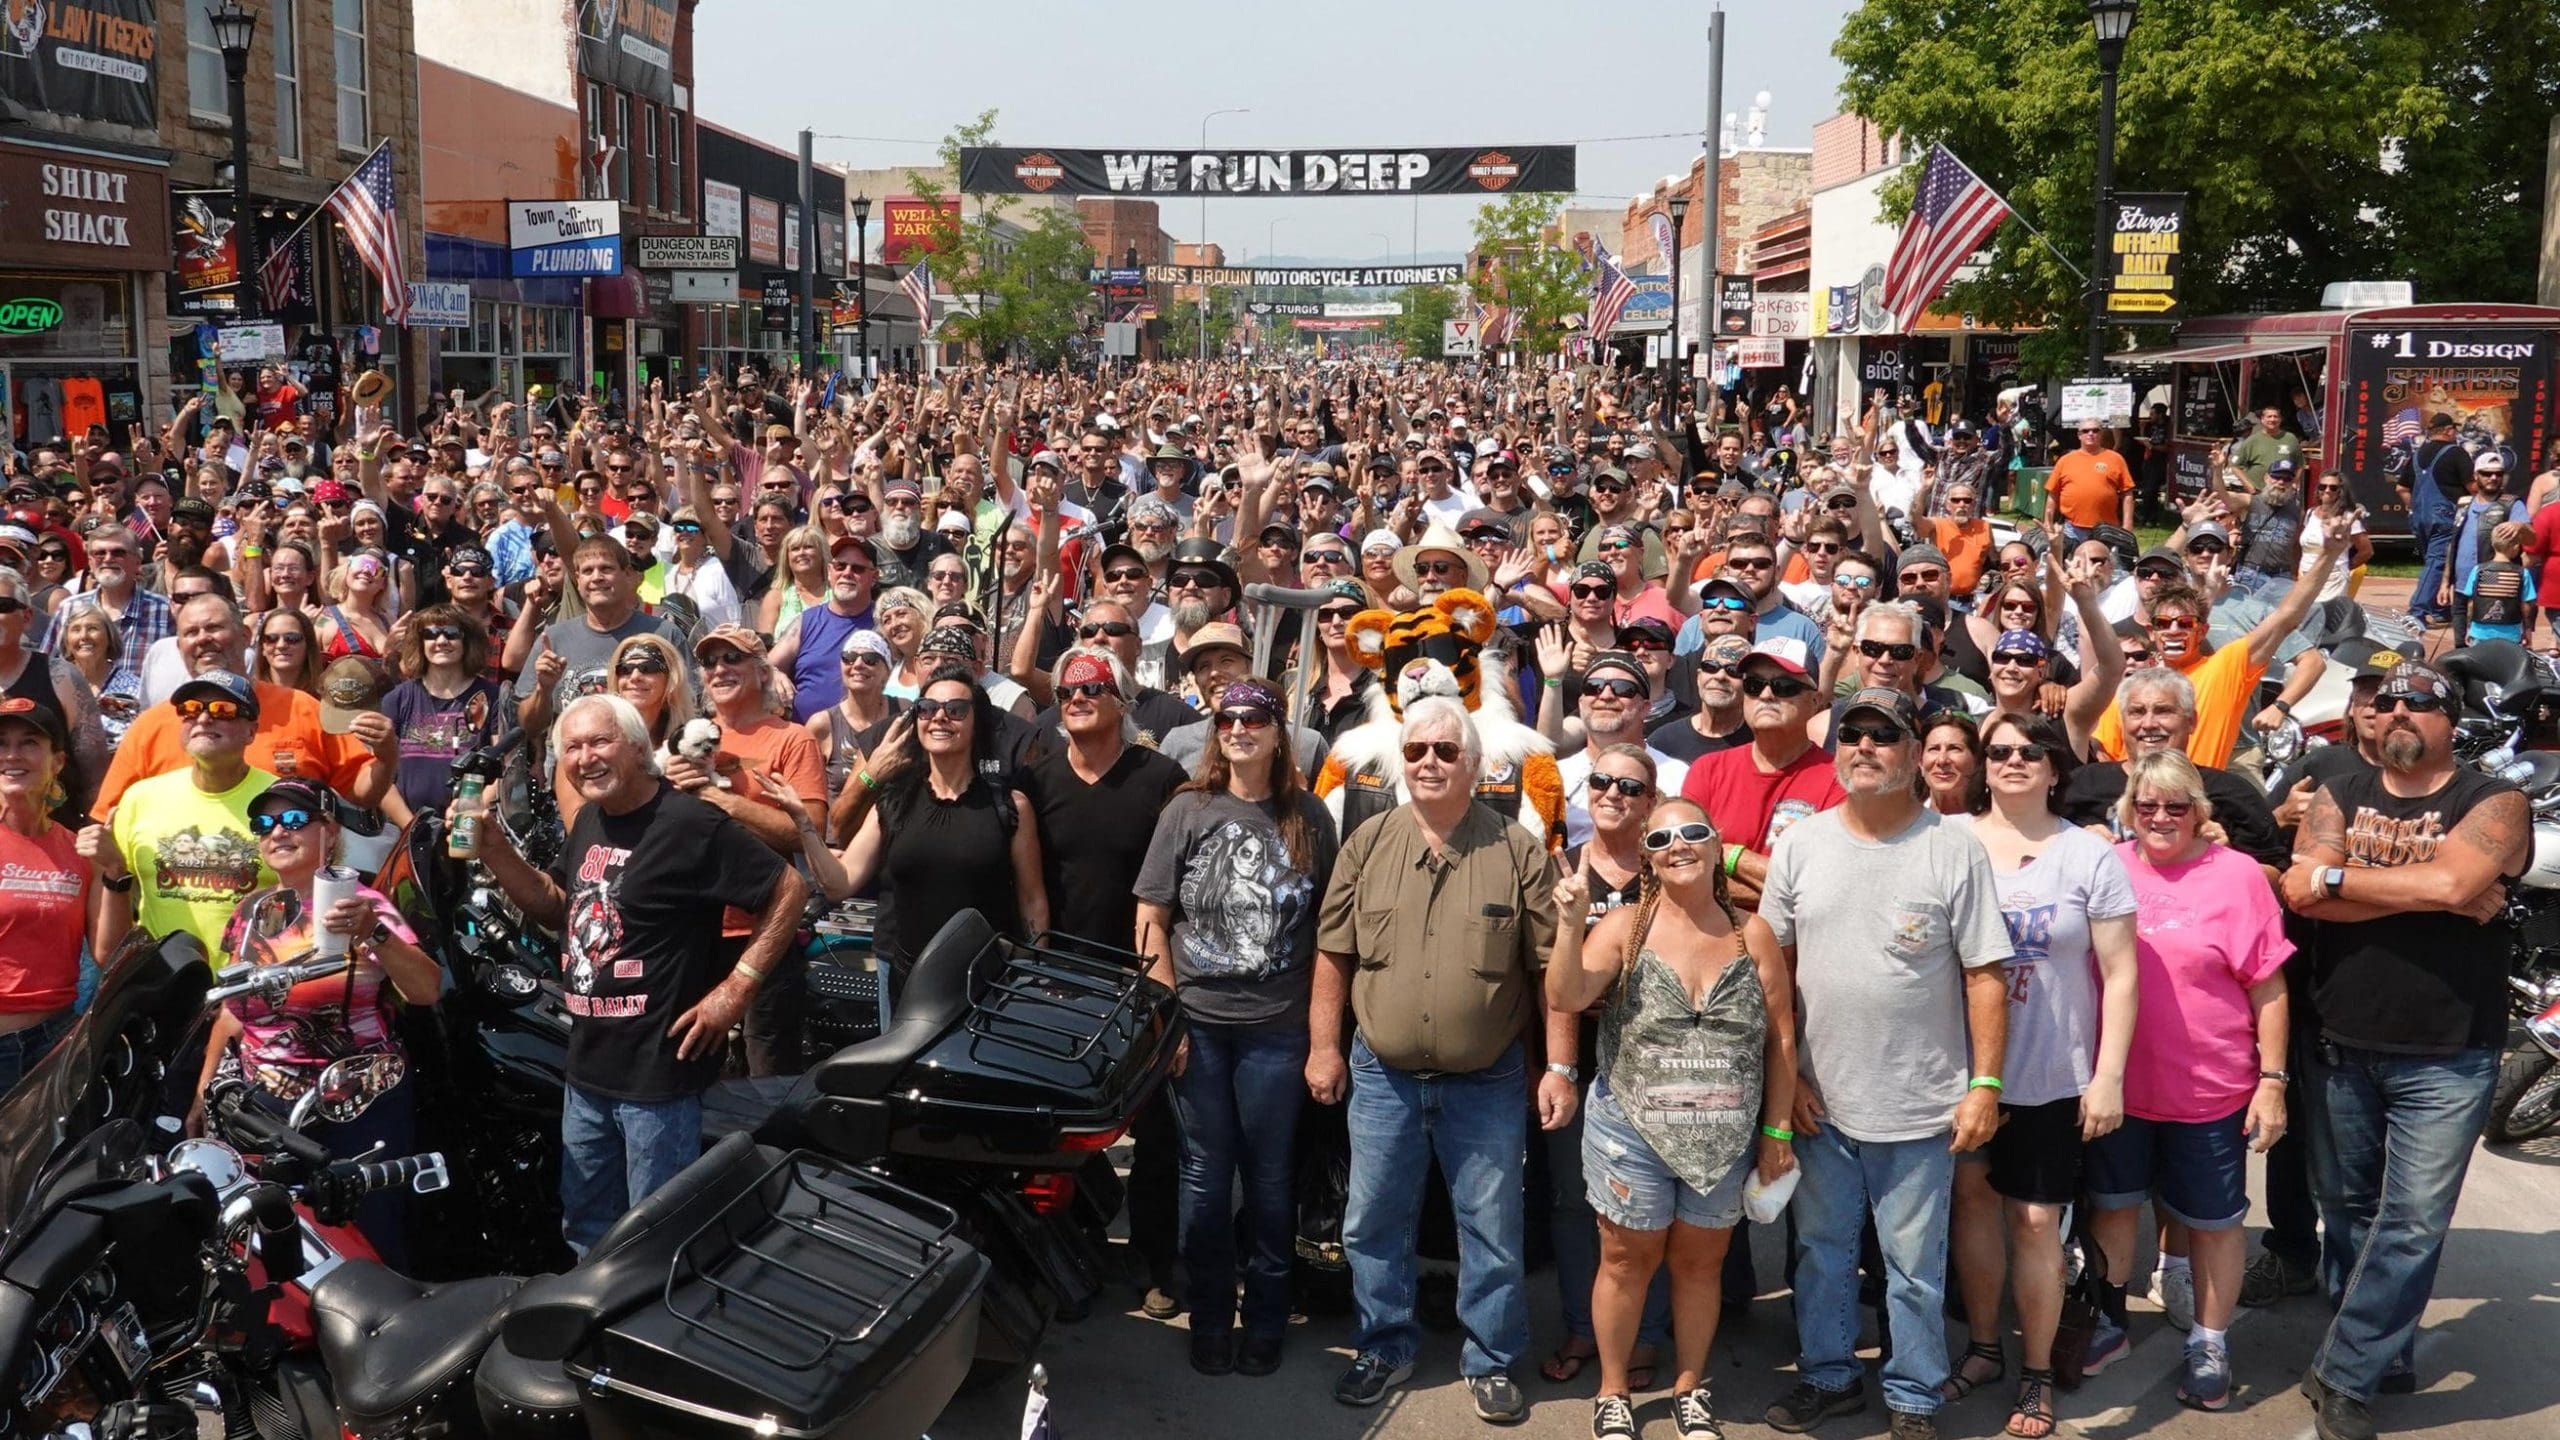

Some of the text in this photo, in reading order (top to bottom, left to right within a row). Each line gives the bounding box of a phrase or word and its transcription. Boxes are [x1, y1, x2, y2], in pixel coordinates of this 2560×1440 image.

[47, 1, 154, 59] LAW TIGERS
[1102, 153, 1430, 192] WE RUN DEEP
[42, 164, 127, 203] SHIRT
[524, 209, 555, 226] Town
[892, 209, 950, 222] WELLS
[2116, 207, 2179, 236] Sturgis
[44, 209, 131, 246] SHACK
[557, 218, 603, 237] Country
[641, 239, 735, 250] DUNGEON BAR
[2113, 232, 2180, 253] OFFICIAL
[532, 248, 614, 272] PLUMBING
[647, 251, 730, 260] DOWNSTAIRS
[2123, 254, 2169, 274] RALLY
[188, 273, 229, 289] SINCE 1975
[1147, 266, 1458, 287] RUSS BROWN MOTORCYCLE ATTORNEYS
[766, 288, 787, 297] RUN
[1725, 292, 1749, 300] RUN
[1728, 282, 1747, 291] WE
[418, 285, 466, 311] WebCam
[764, 297, 790, 306] DEEP
[1722, 301, 1751, 310] DEEP
[1752, 298, 1808, 314] eakfast
[0, 304, 55, 328] OPEN
[1275, 303, 1319, 314] STURGIS
[1768, 317, 1798, 334] Day
[2371, 332, 2416, 358] #1
[2383, 367, 2521, 403] STURGIS
[2355, 380, 2369, 472] SOLD HERE
[2530, 379, 2545, 472] SOLD HERE
[1357, 774, 1383, 787] TANK
[1, 863, 80, 882] Sturgis
[179, 859, 205, 868] 2021
[591, 993, 649, 1018] RALLY
[1659, 1058, 1731, 1069] STURGIS
[1666, 1110, 1695, 1125] HORSE
